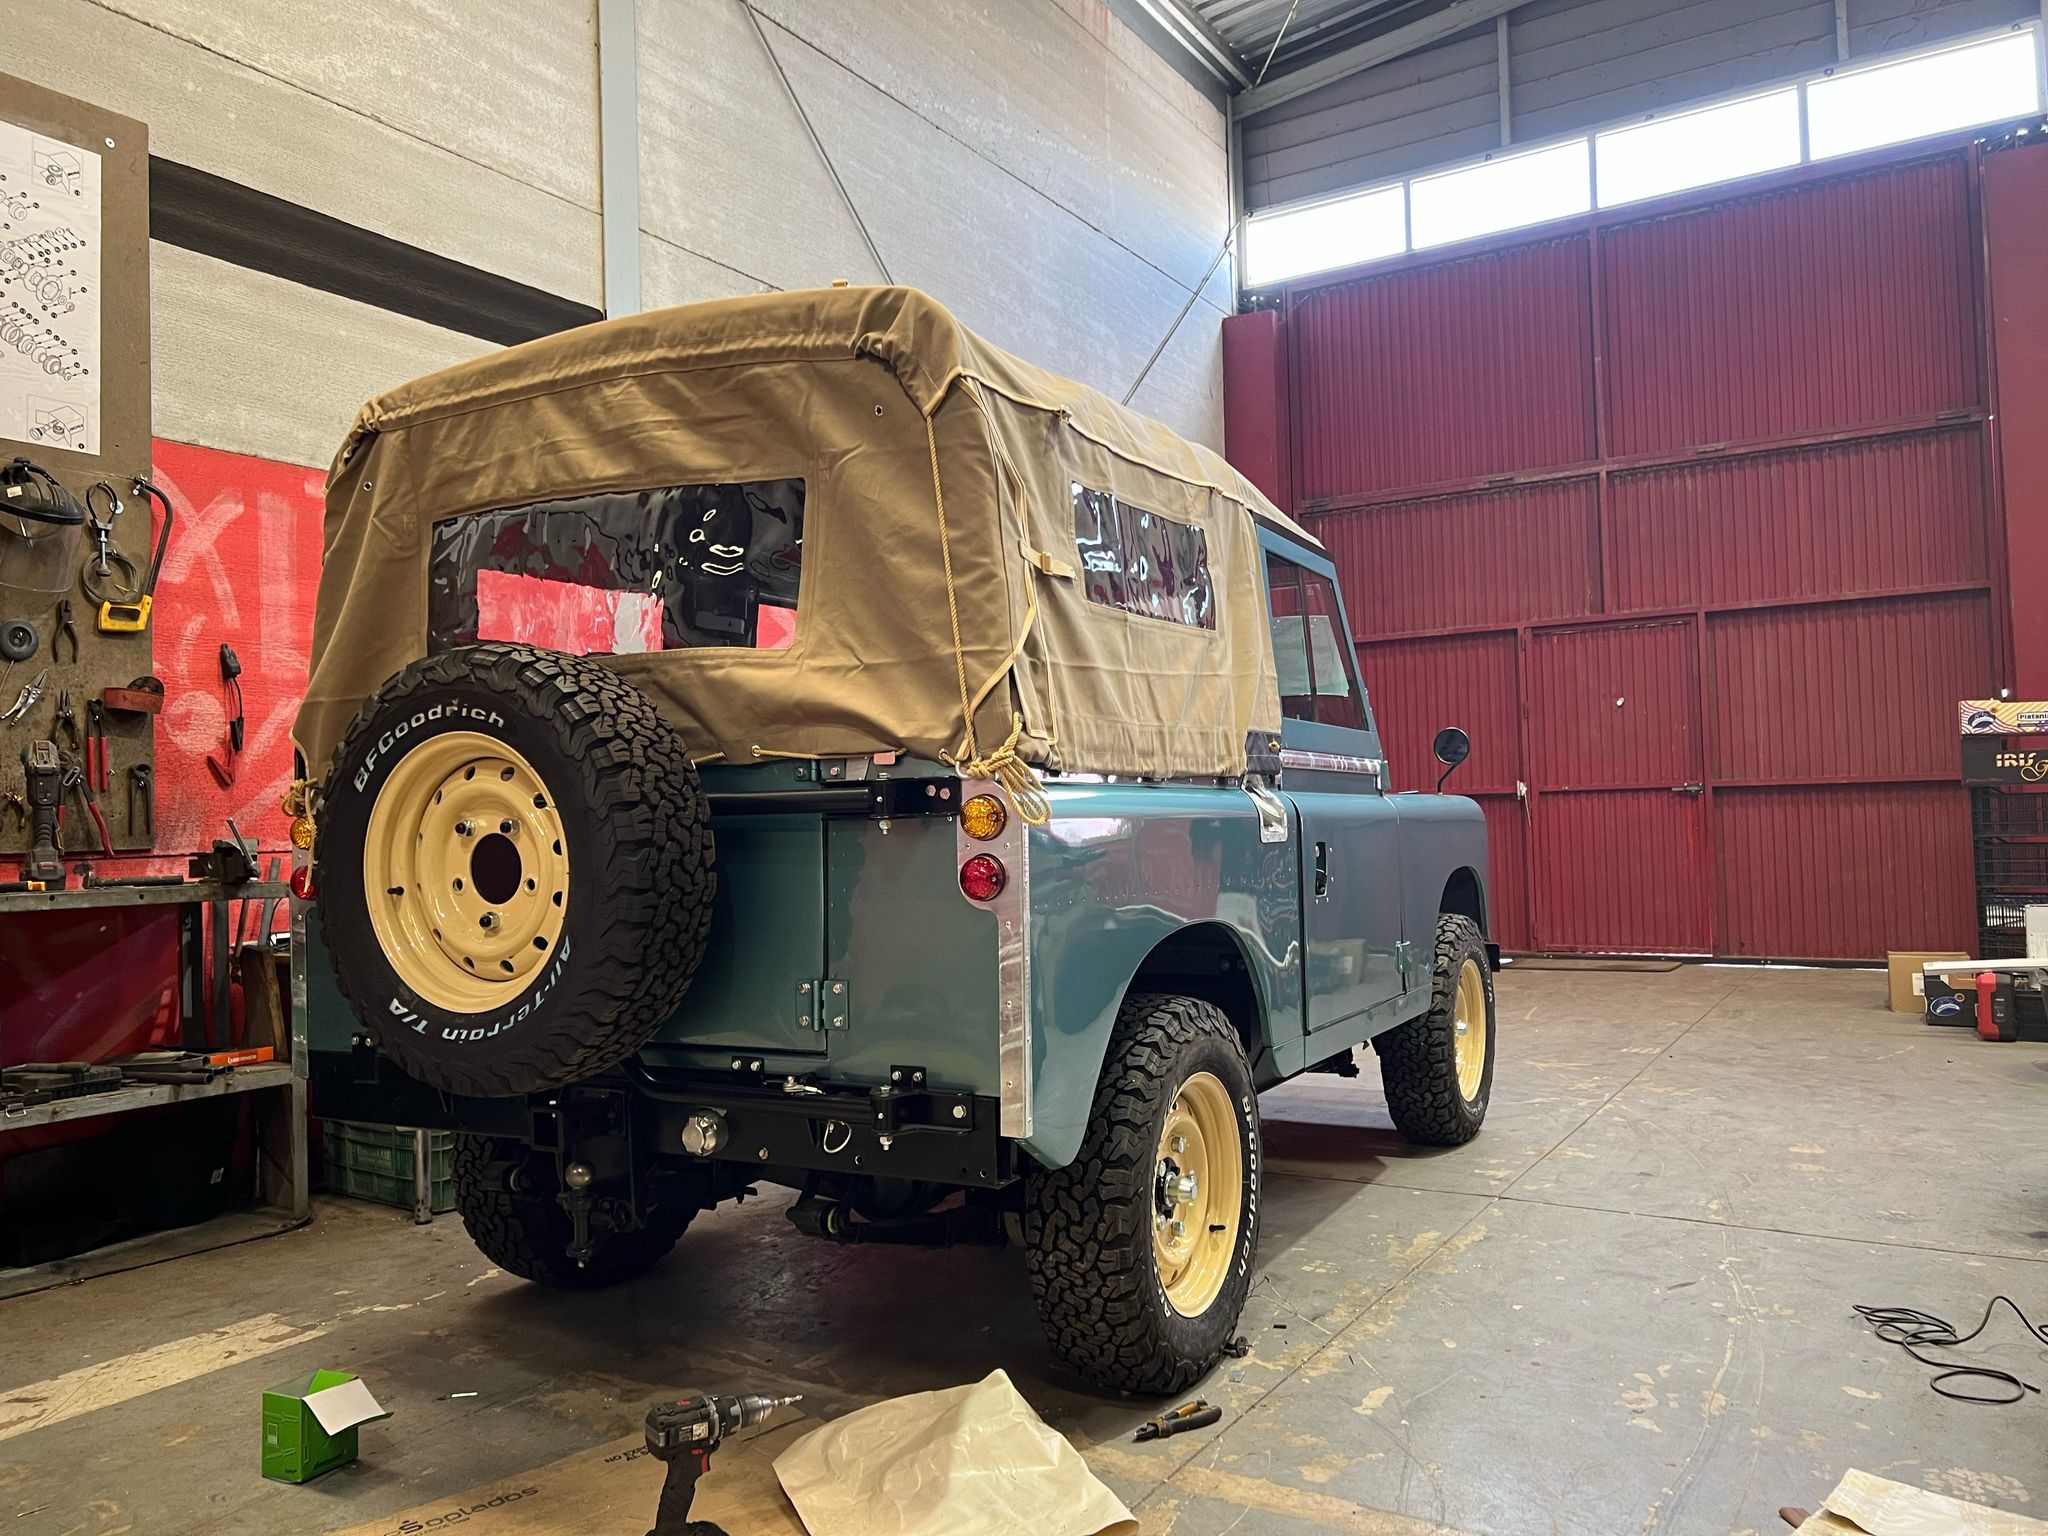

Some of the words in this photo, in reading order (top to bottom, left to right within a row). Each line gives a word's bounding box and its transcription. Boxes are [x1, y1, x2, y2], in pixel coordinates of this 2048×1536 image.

[353, 702, 505, 793] BFGoodrich
[388, 997, 429, 1036] T/A
[1239, 1095, 1257, 1278] BFGoodrich
